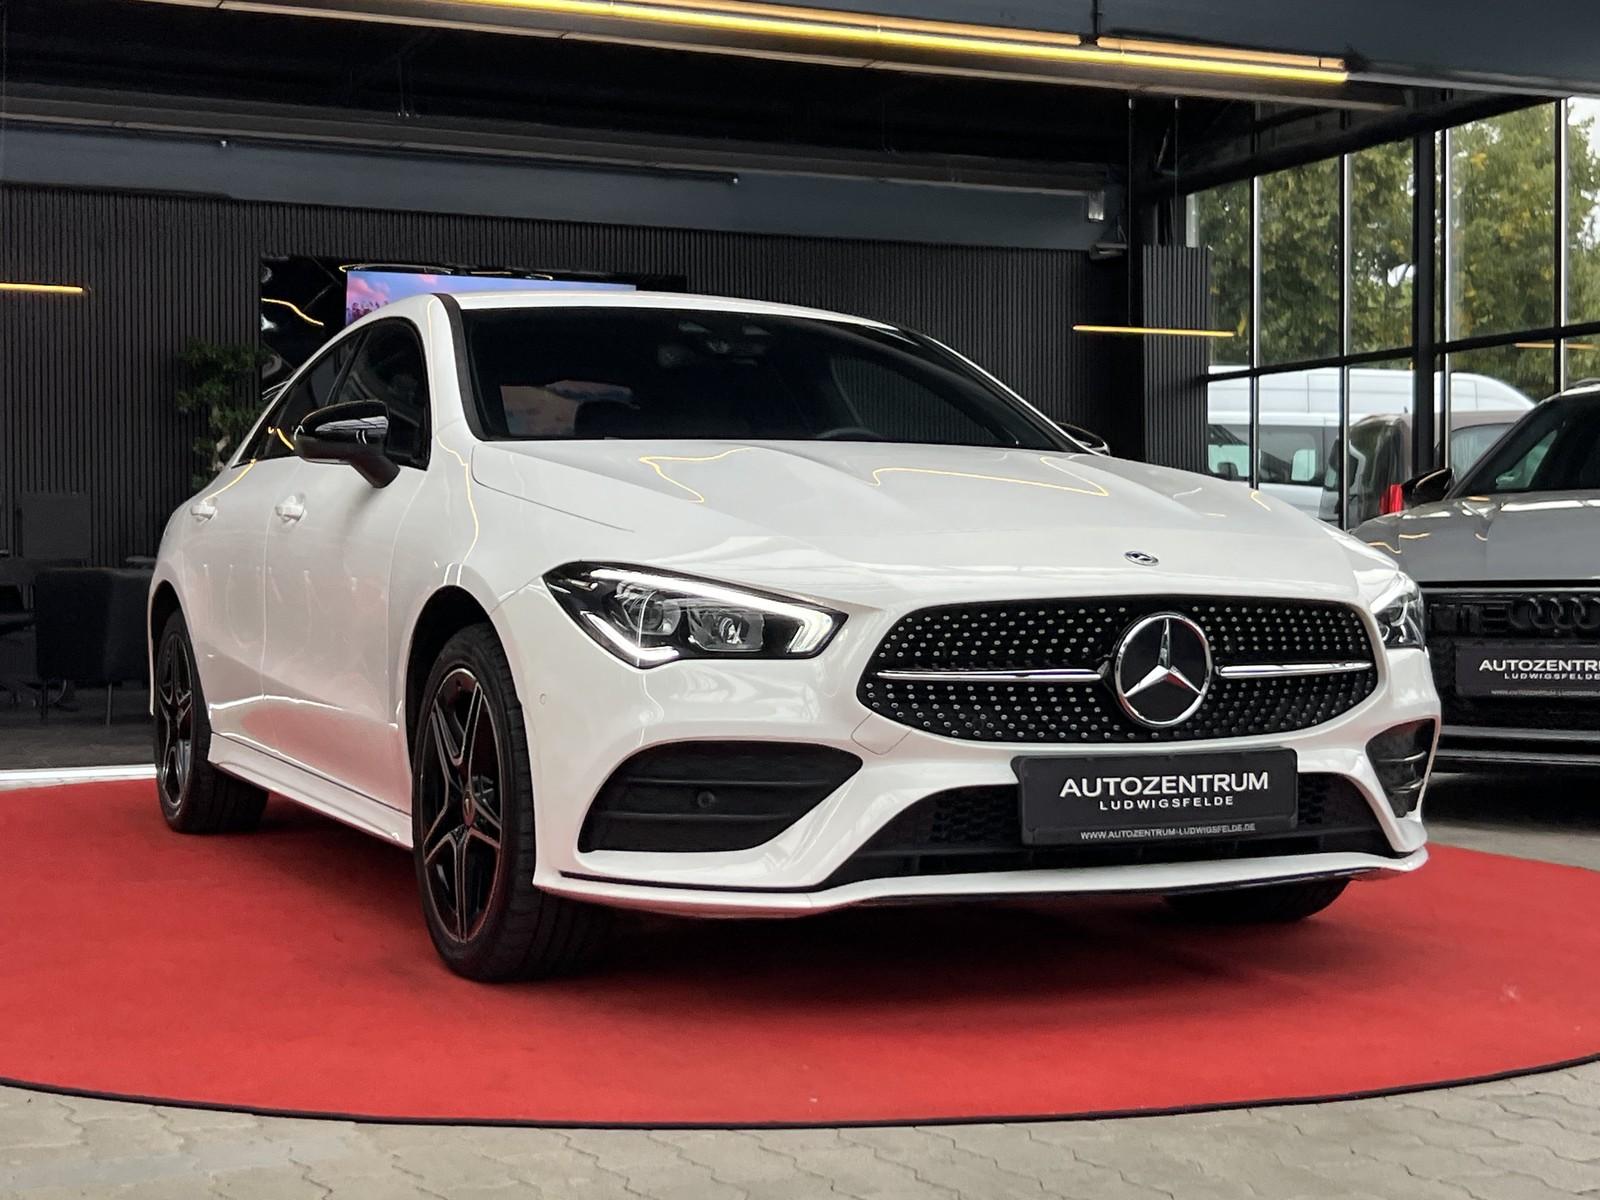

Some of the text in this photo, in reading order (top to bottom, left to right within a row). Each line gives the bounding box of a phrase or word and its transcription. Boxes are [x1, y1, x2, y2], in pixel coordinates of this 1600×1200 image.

[1479, 659, 1600, 672] AUTOZENTR
[1059, 771, 1269, 798] AUTOZENTRUM
[1099, 796, 1234, 811] LUDWIGSFELDE
[1080, 823, 1256, 840] WWW.AUTOZENTRUM-LUDWIGSFELDE.DE
